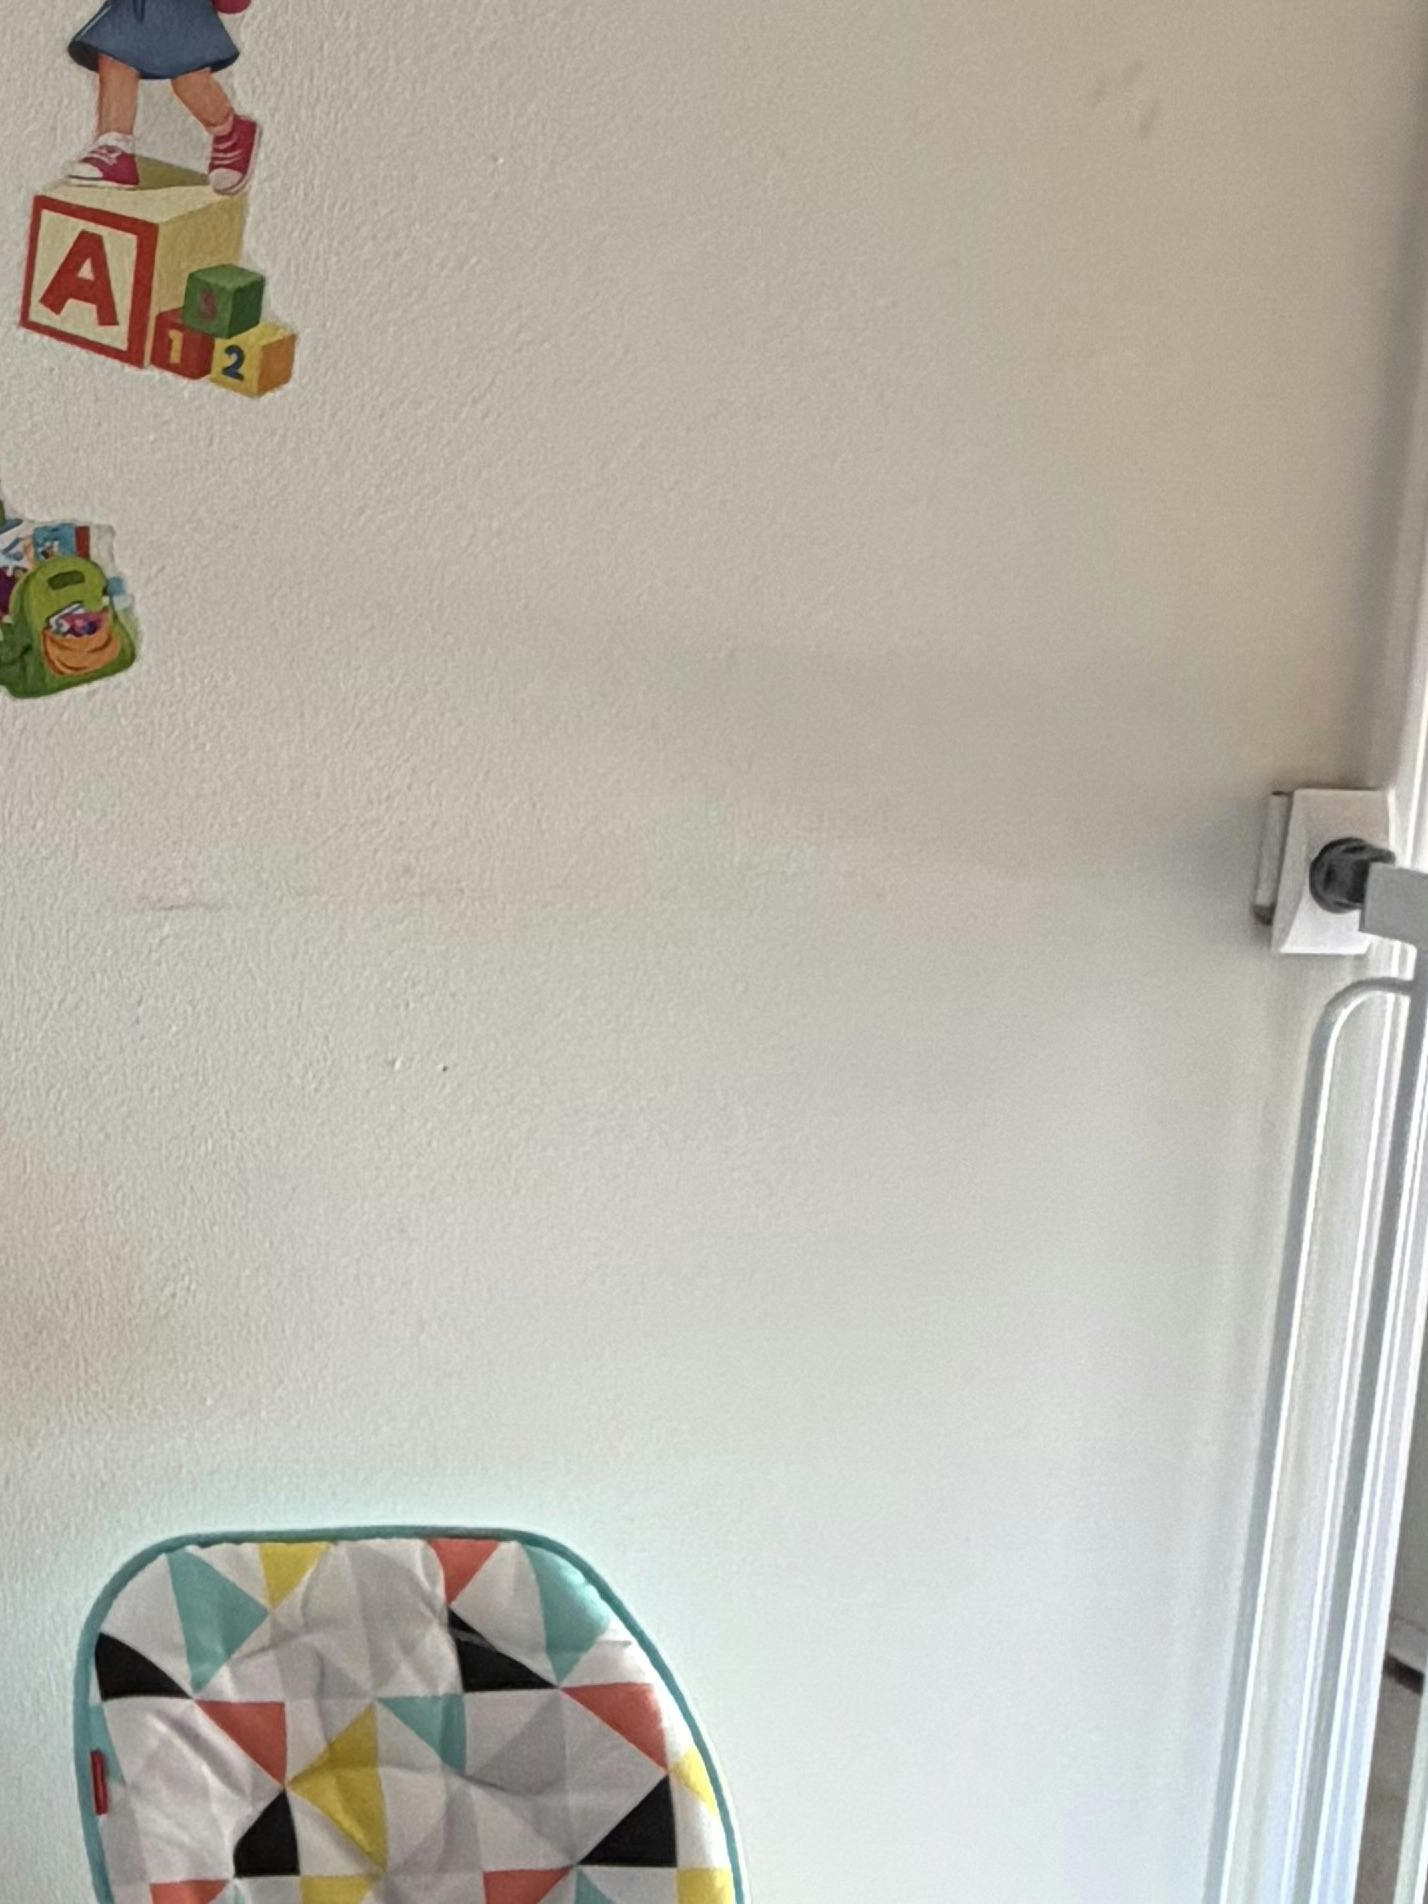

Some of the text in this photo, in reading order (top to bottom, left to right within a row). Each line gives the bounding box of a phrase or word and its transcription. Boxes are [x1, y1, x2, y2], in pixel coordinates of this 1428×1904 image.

[39, 229, 120, 327] A
[167, 329, 183, 365] 1
[221, 344, 245, 382] 2
